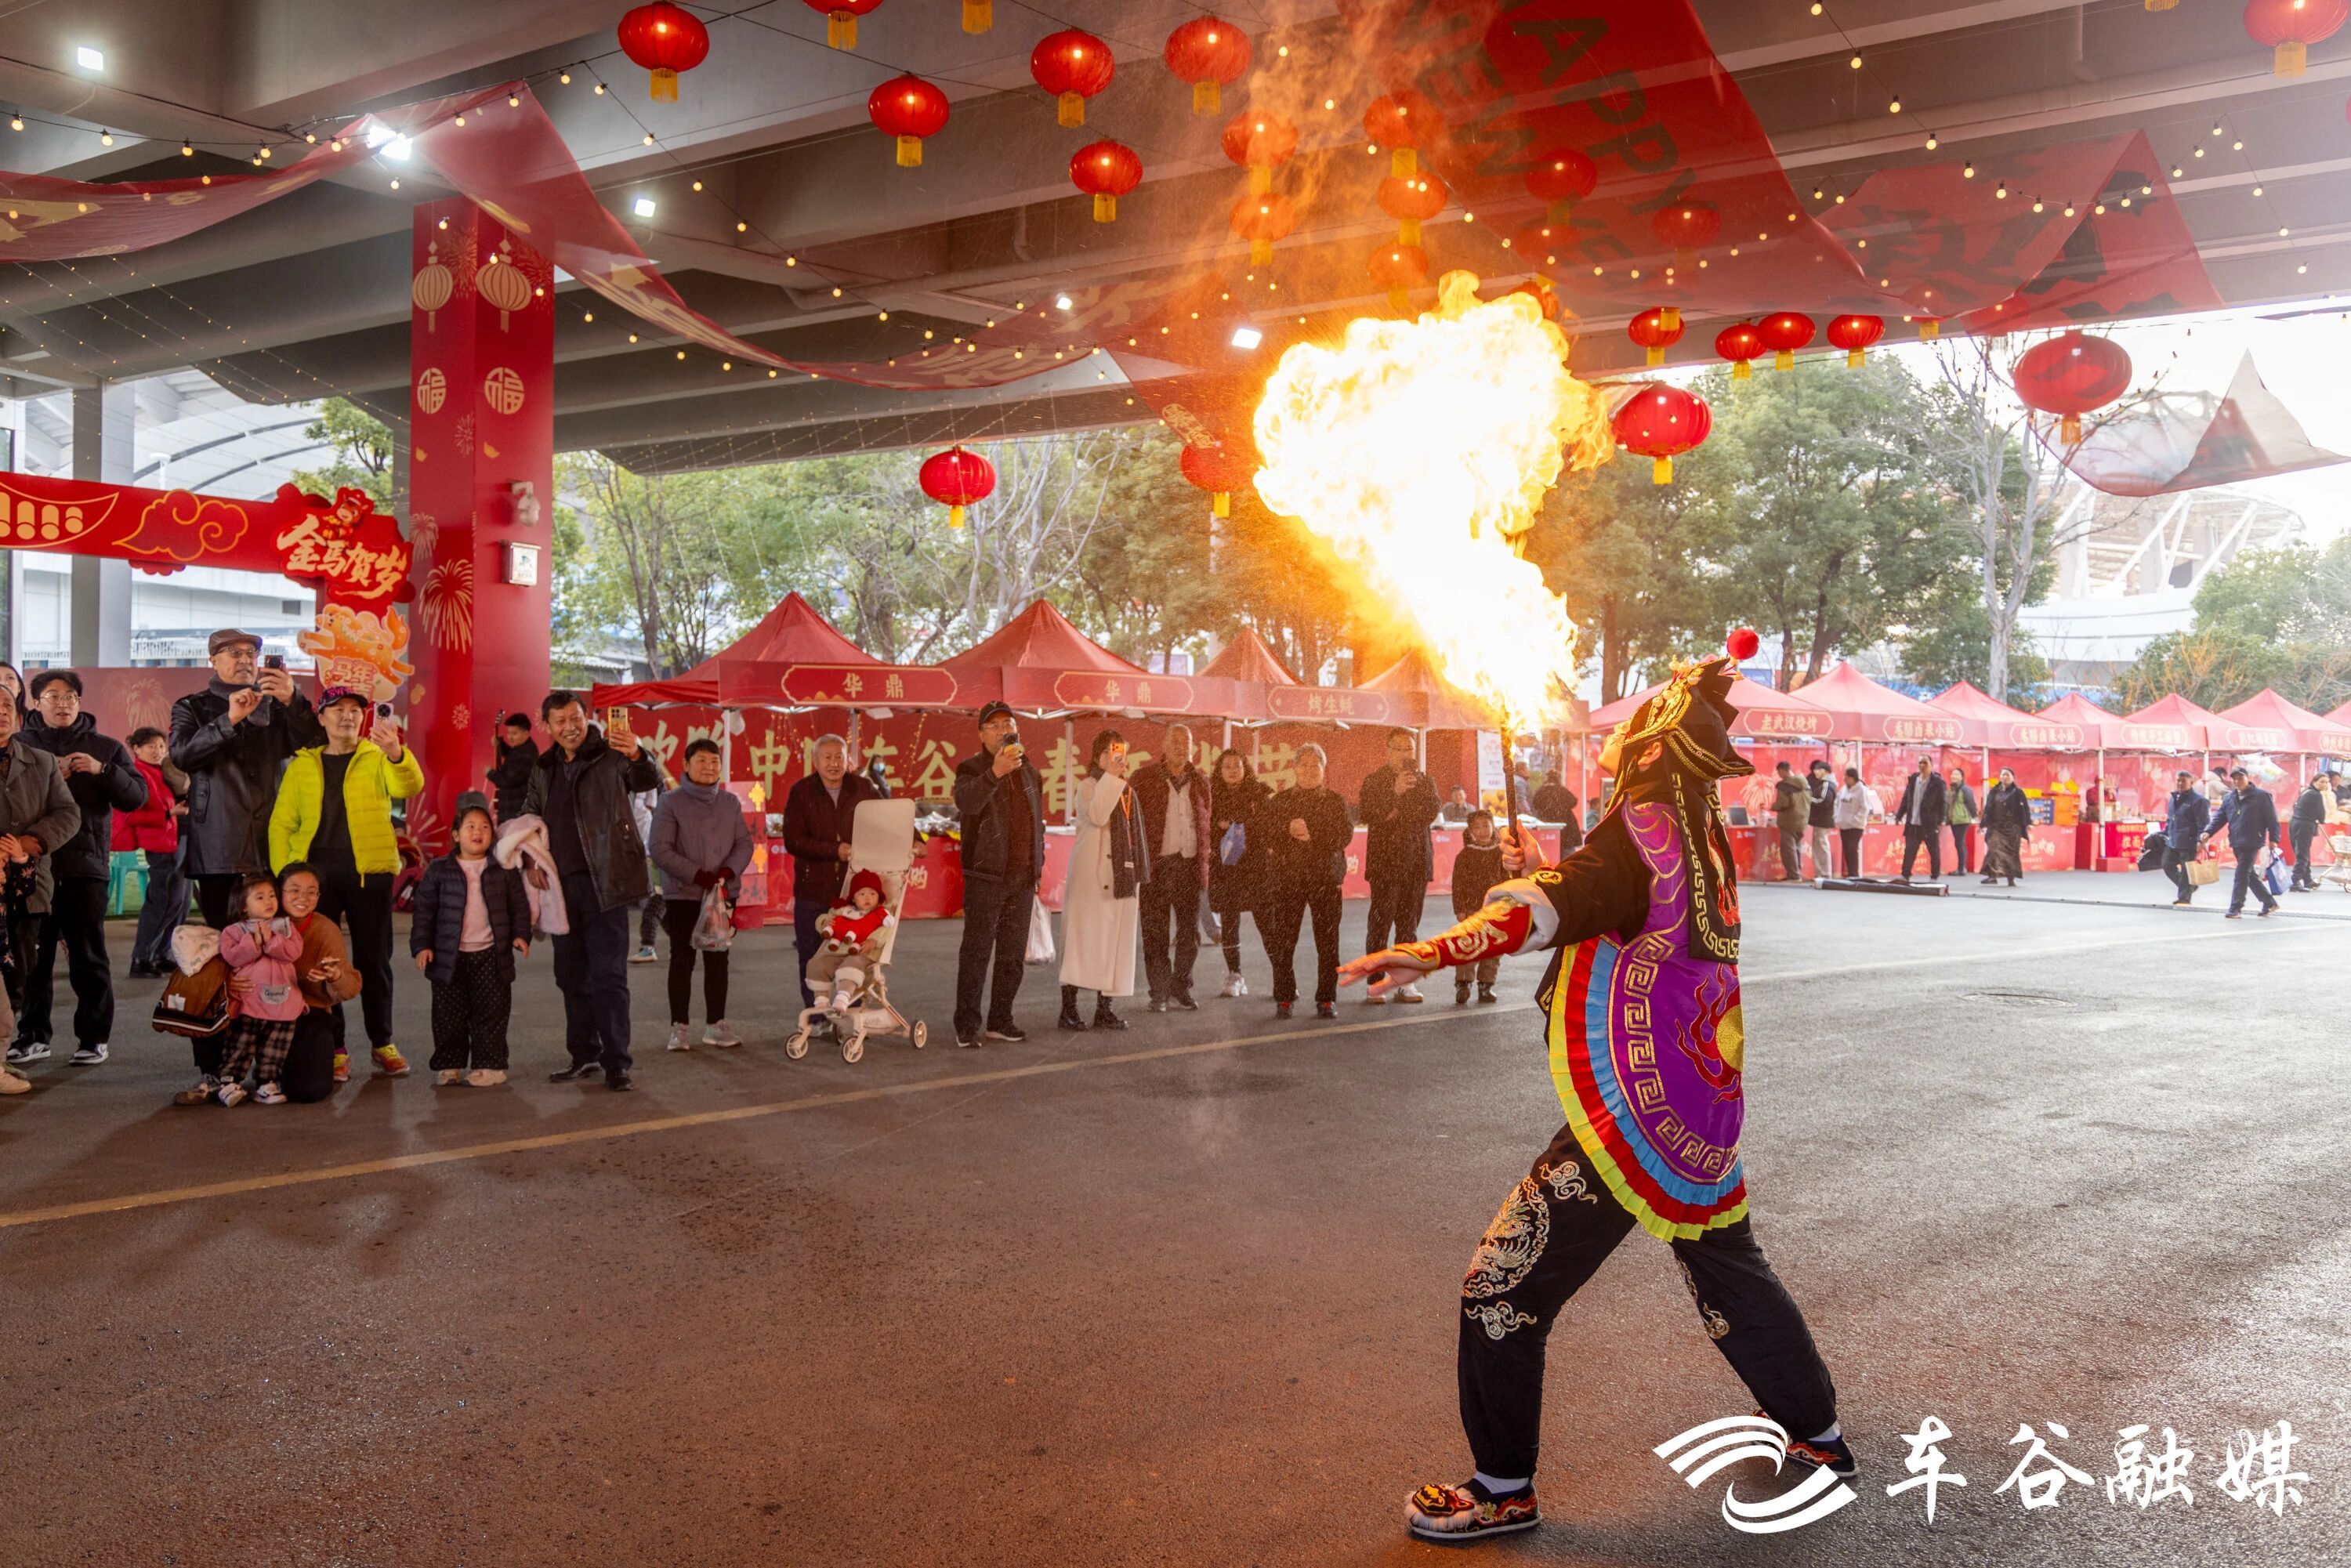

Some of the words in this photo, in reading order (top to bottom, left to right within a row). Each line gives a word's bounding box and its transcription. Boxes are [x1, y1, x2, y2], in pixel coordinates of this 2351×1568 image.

[1500, 0, 1722, 217] APPY
[484, 367, 525, 415] 福
[277, 513, 408, 599] 金马贺岁
[842, 672, 904, 699] 华鼎
[1104, 679, 1151, 704] 华鼎
[1761, 712, 1818, 733] 老武汉烧烤
